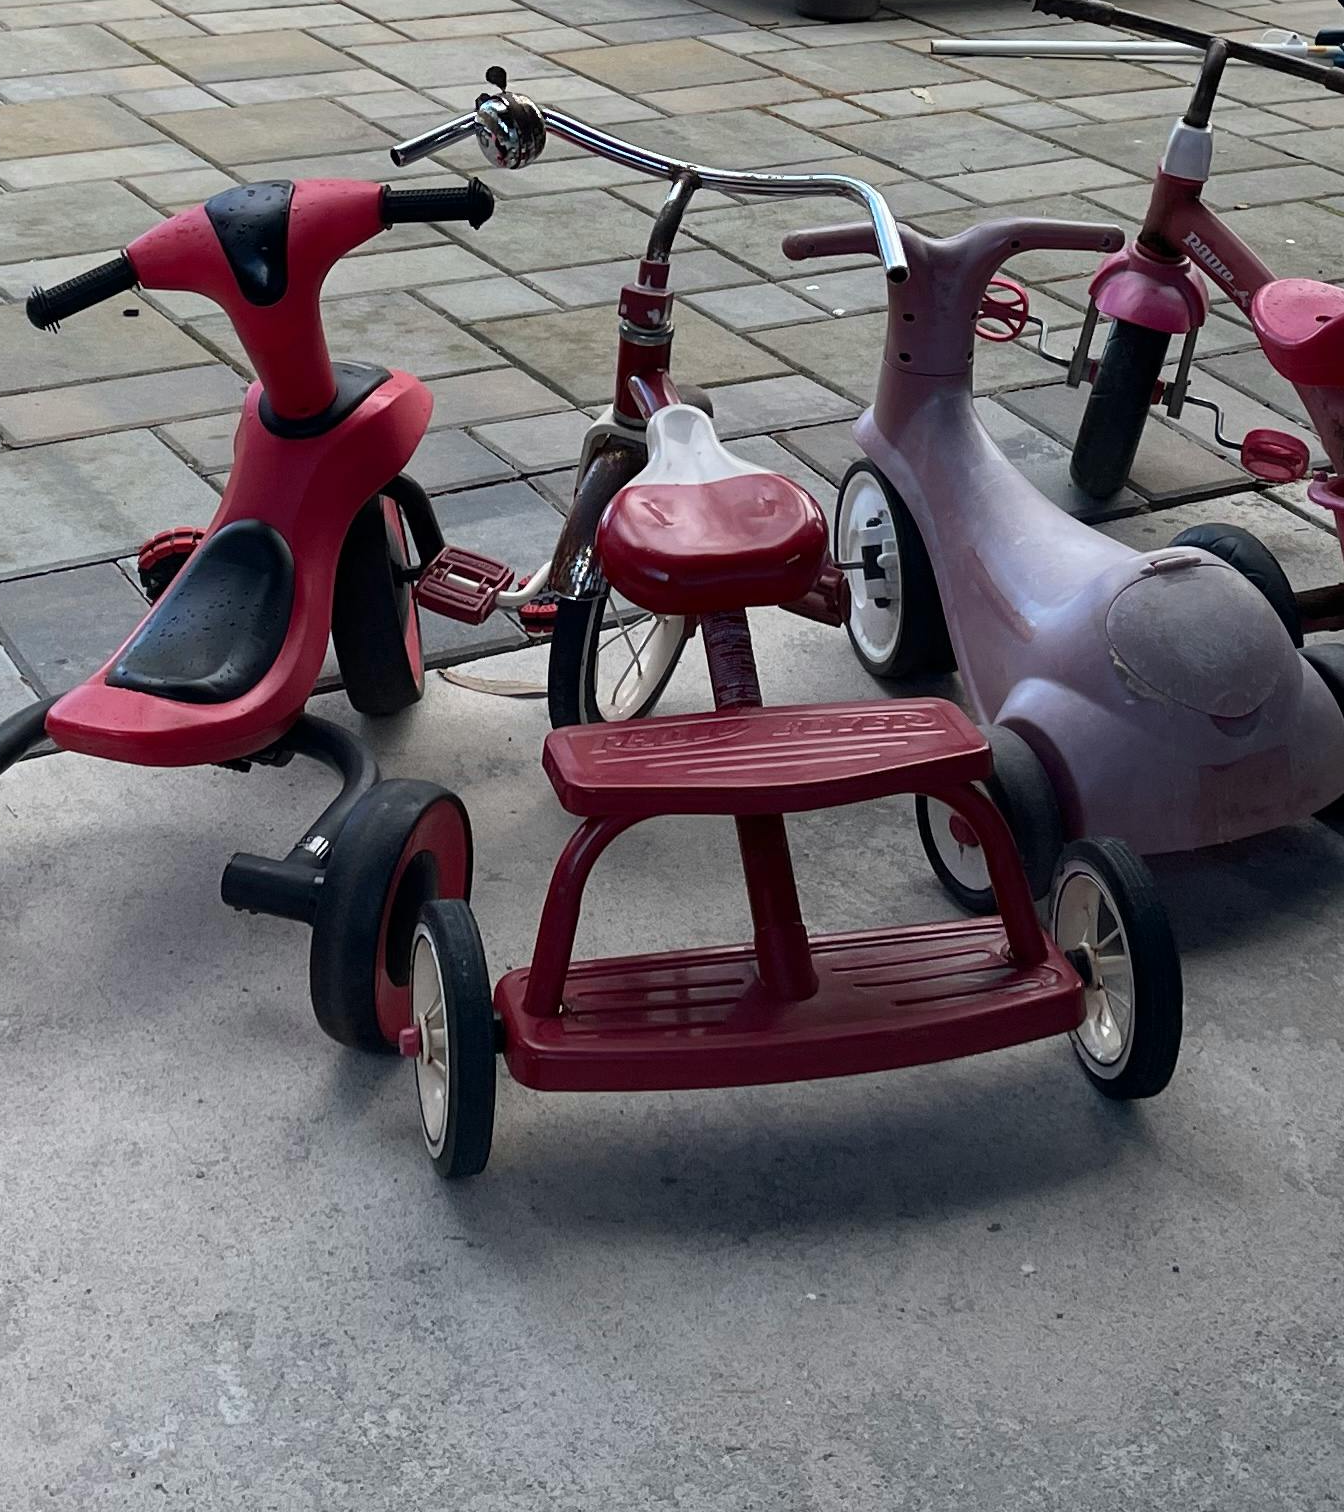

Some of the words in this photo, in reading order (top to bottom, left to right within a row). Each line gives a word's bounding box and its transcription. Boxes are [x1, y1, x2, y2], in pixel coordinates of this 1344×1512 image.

[1182, 231, 1235, 283] RADIO
[591, 720, 752, 755] RADIO
[772, 710, 939, 737] FLYER
